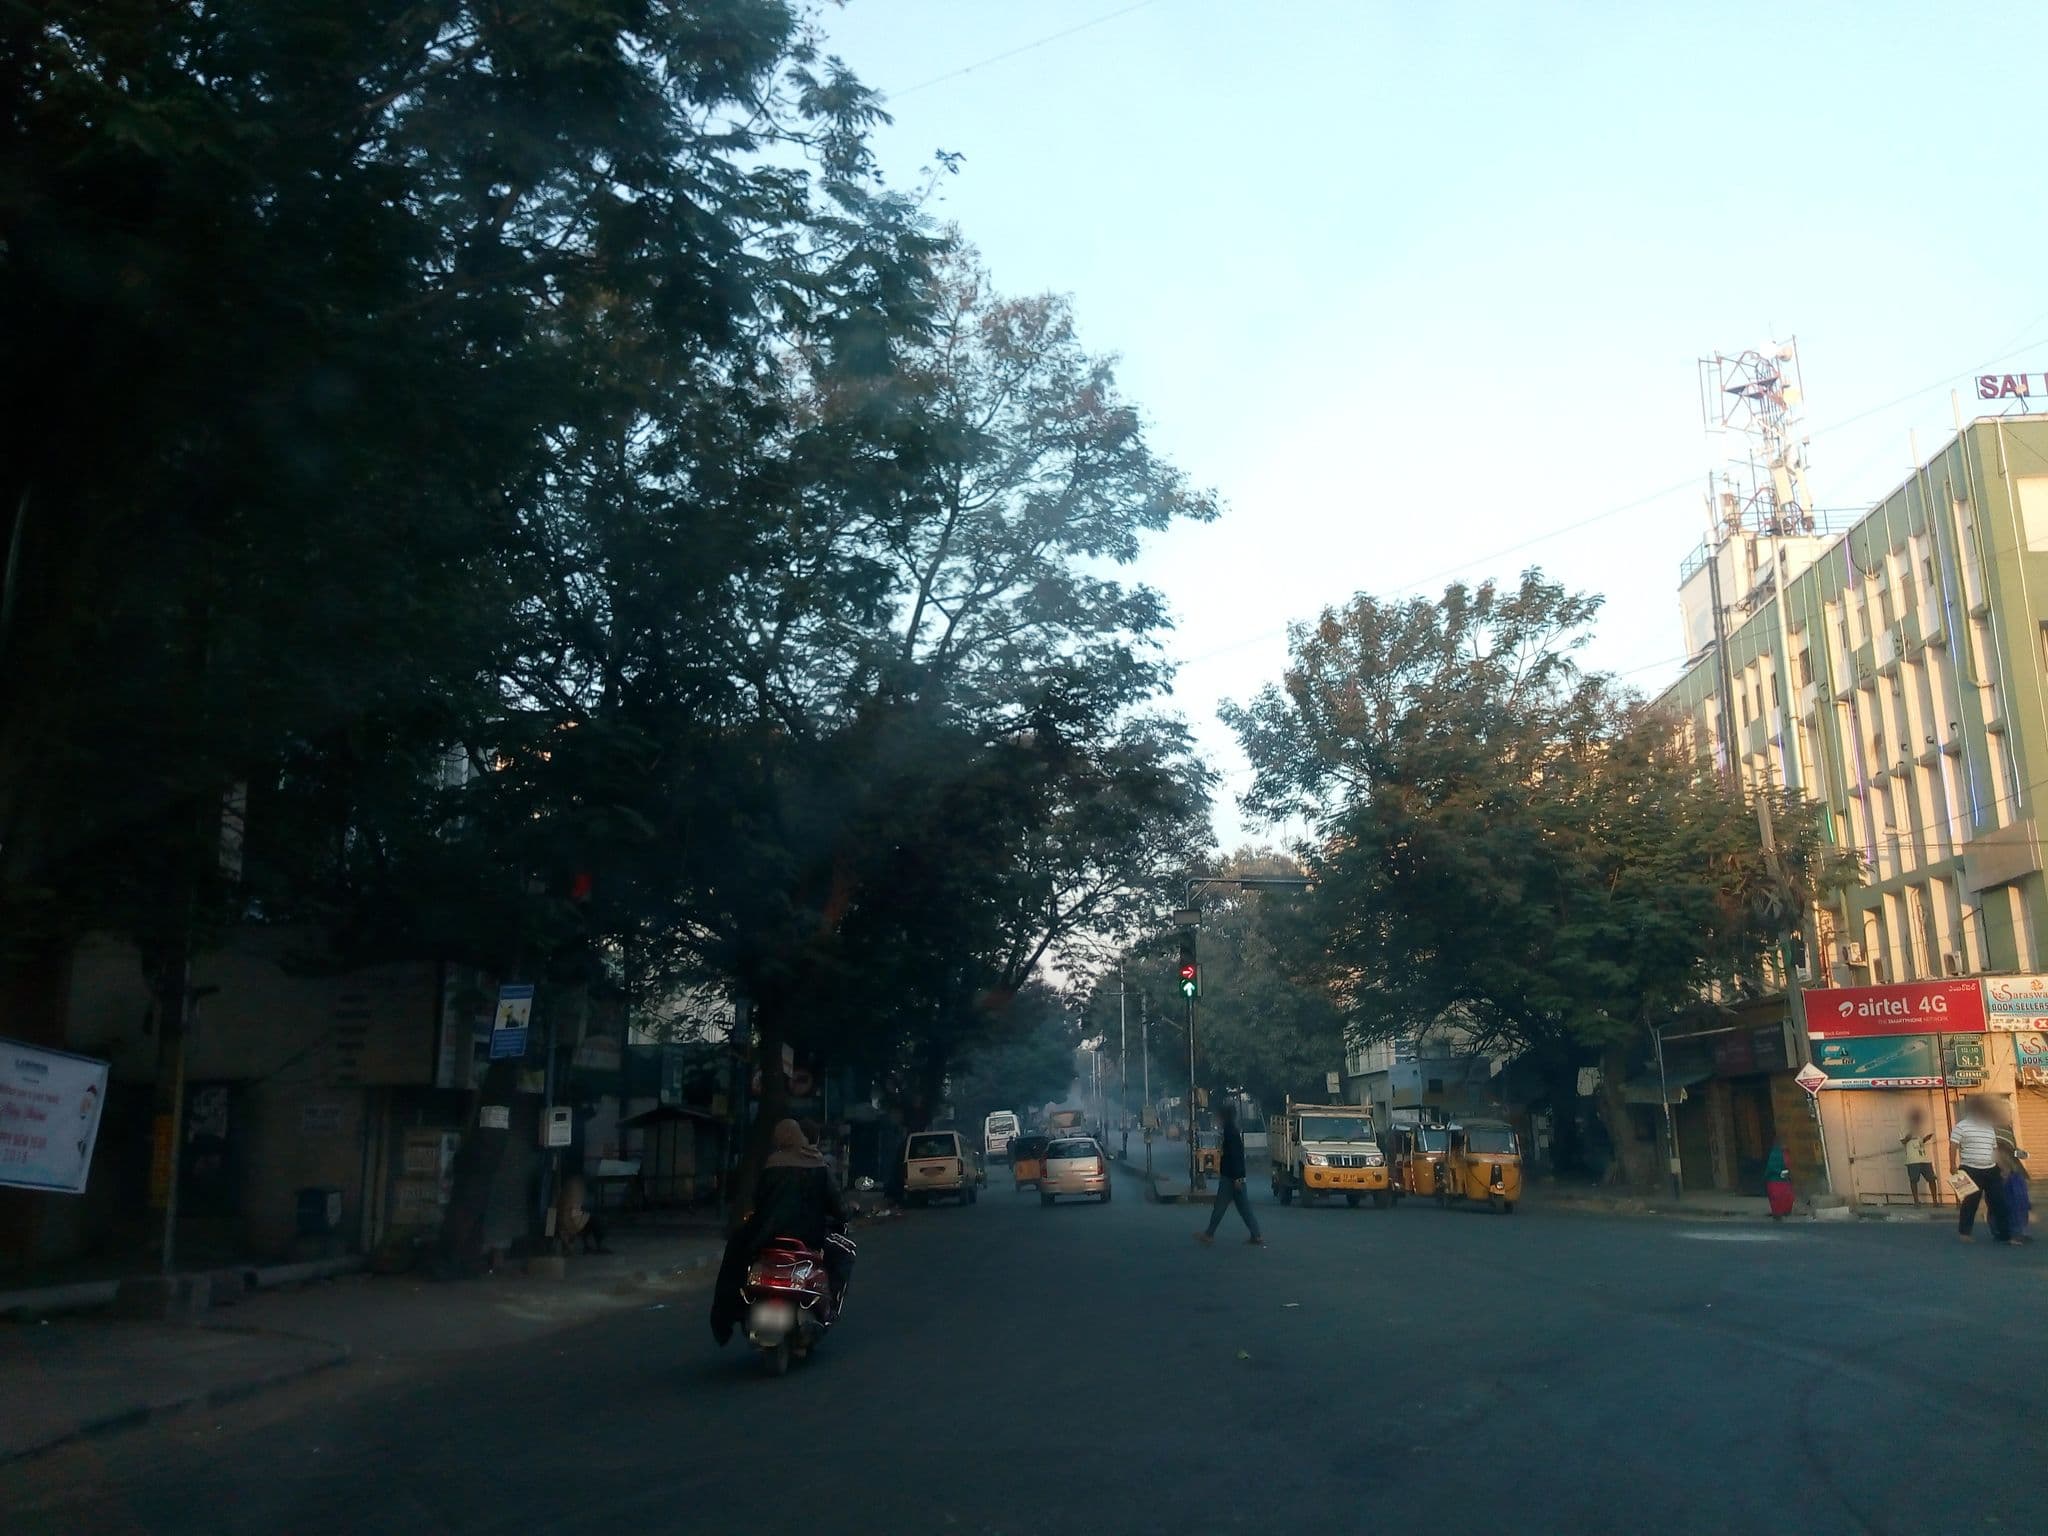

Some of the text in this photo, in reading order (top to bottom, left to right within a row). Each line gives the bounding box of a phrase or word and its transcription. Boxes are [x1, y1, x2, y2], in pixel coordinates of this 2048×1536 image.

[1980, 373, 2030, 399] SAI
[1857, 995, 1947, 1017] airtel 4G
[1991, 1003, 2014, 1012] BOOK
[2022, 1056, 2043, 1065] BOOK
[1872, 1078, 1940, 1087] XEROX
